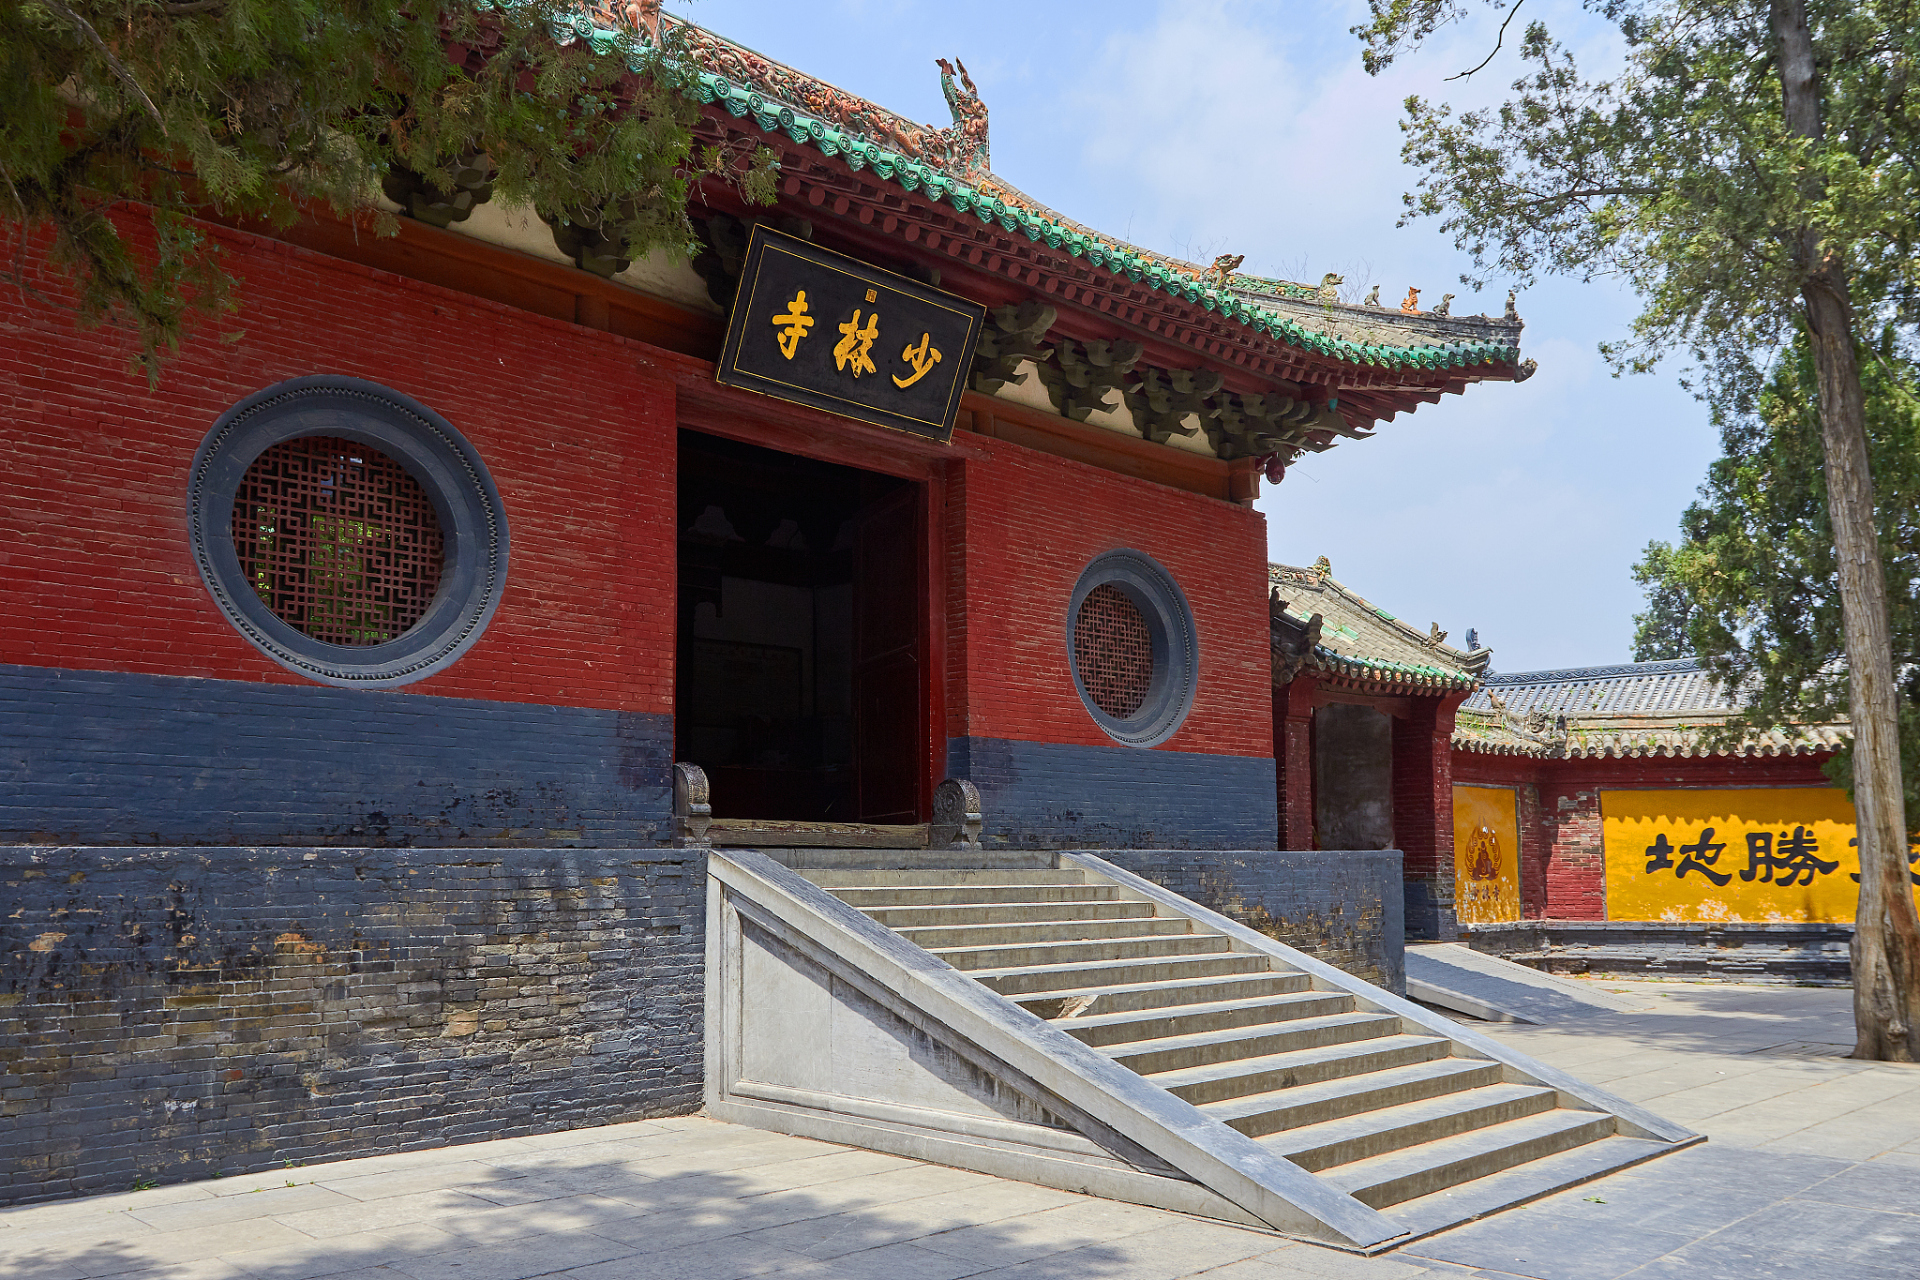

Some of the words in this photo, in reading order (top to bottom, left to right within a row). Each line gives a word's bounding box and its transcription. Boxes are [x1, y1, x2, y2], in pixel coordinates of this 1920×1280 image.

[772, 290, 942, 389] 少林寺
[1645, 826, 1920, 887] 勝地
